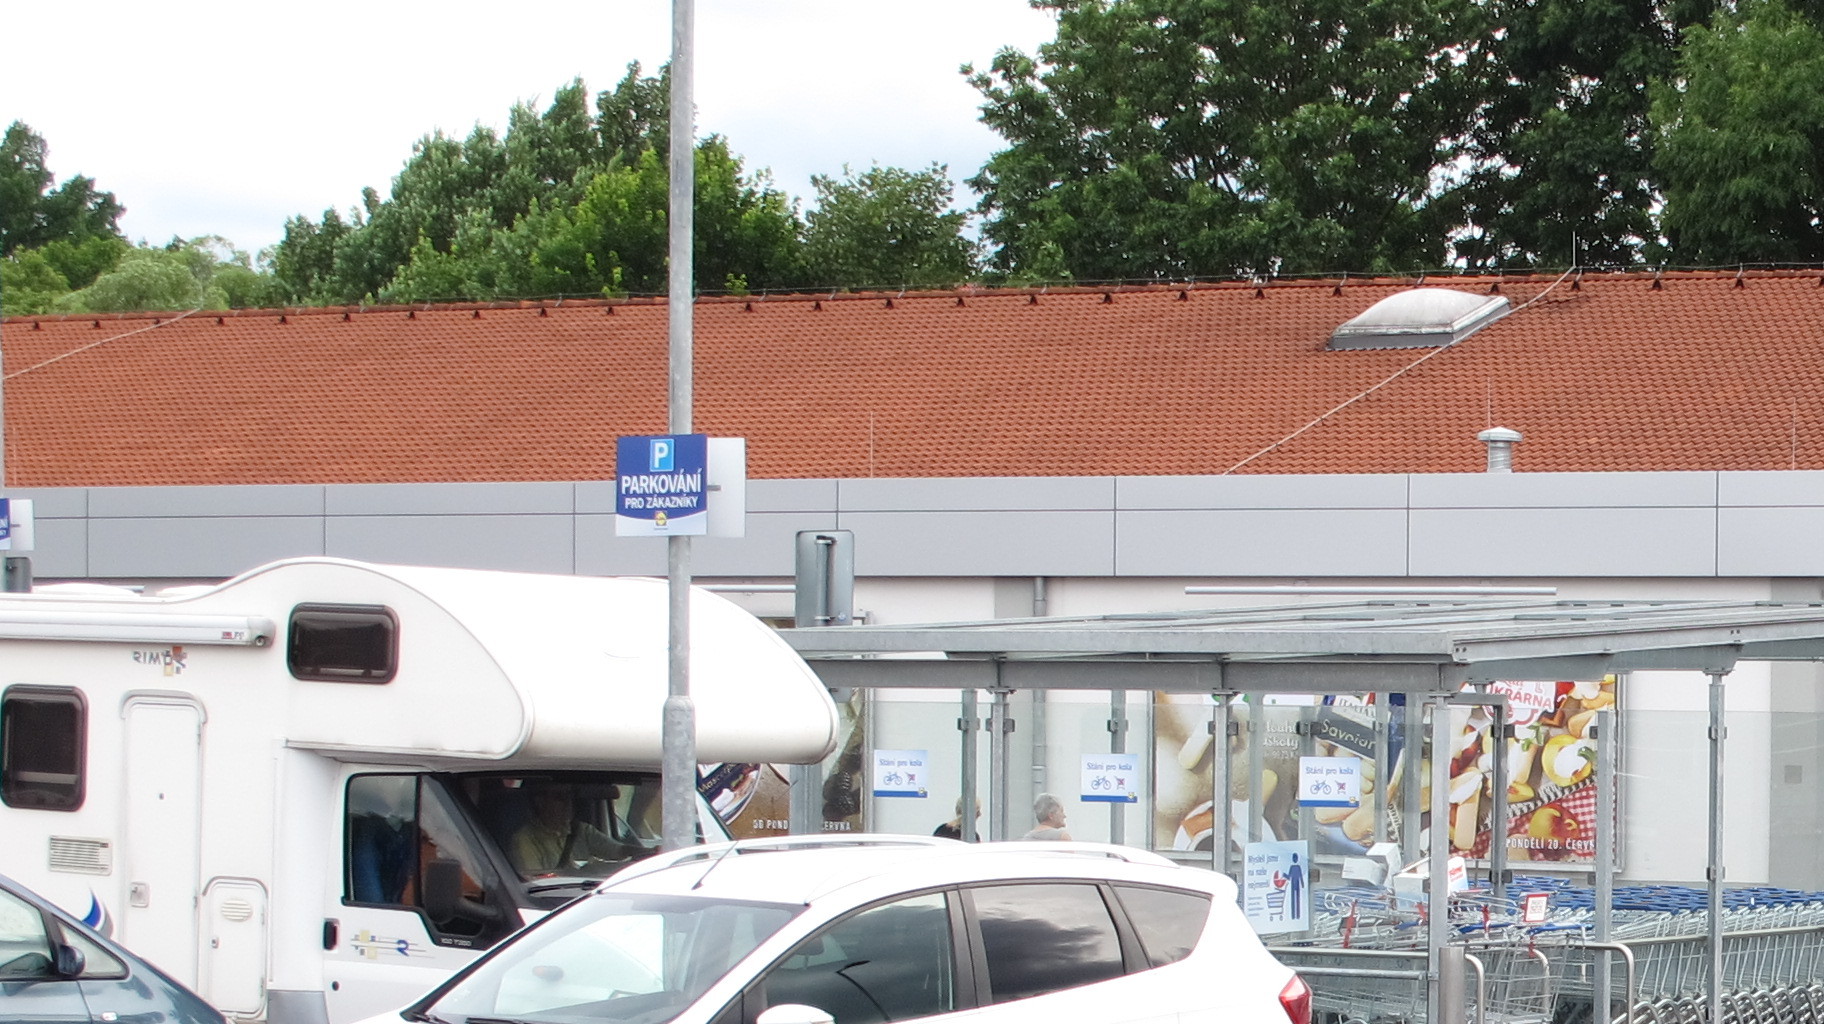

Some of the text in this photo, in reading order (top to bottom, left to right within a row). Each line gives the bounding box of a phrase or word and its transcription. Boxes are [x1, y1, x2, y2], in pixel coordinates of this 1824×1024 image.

[654, 442, 669, 469] P
[621, 468, 702, 494] PARKOVÁNÍ
[625, 494, 698, 509] PRO ZÁKAZNÍKY
[1321, 719, 1376, 750] Savoiar
[766, 819, 789, 830] POND
[822, 821, 851, 831] ERVNA
[1565, 837, 1596, 850] ČERVN
